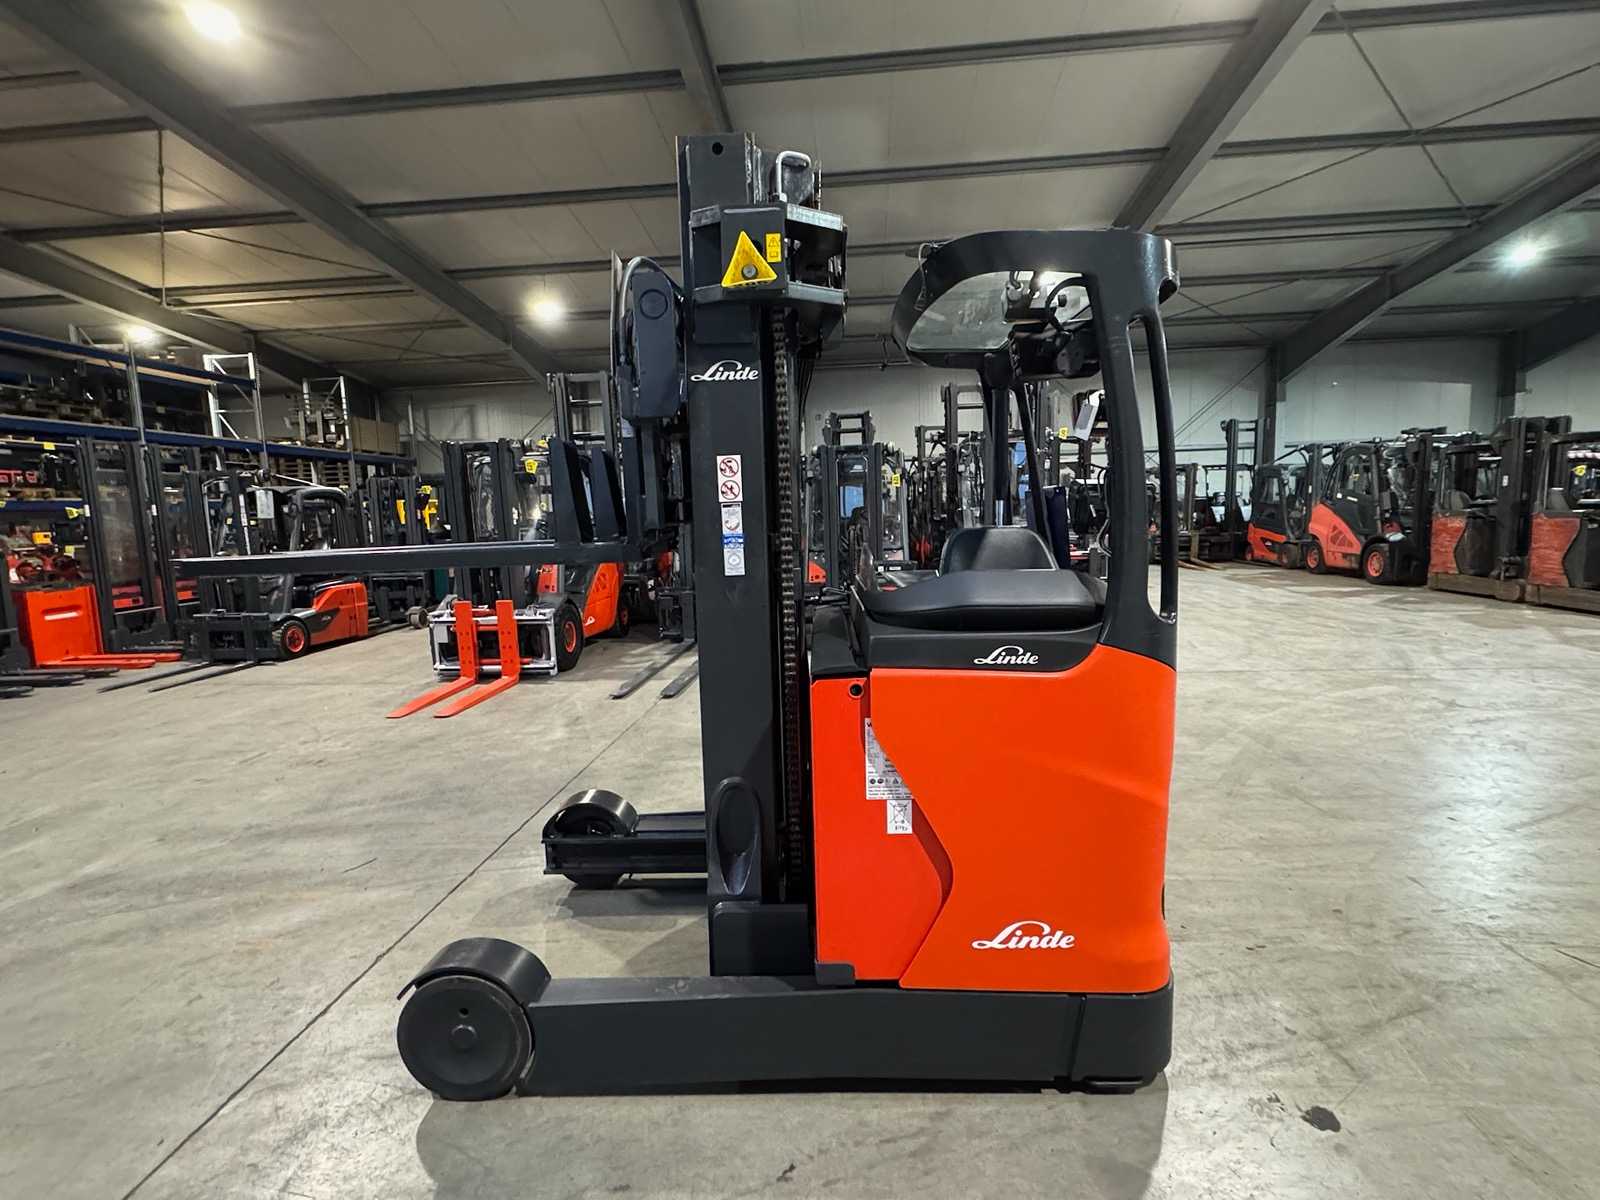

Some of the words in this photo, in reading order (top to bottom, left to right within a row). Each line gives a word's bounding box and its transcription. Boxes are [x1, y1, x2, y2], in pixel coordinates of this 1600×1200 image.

[691, 360, 759, 382] Linde
[973, 645, 1039, 665] Linde
[971, 920, 1075, 949] Linde
